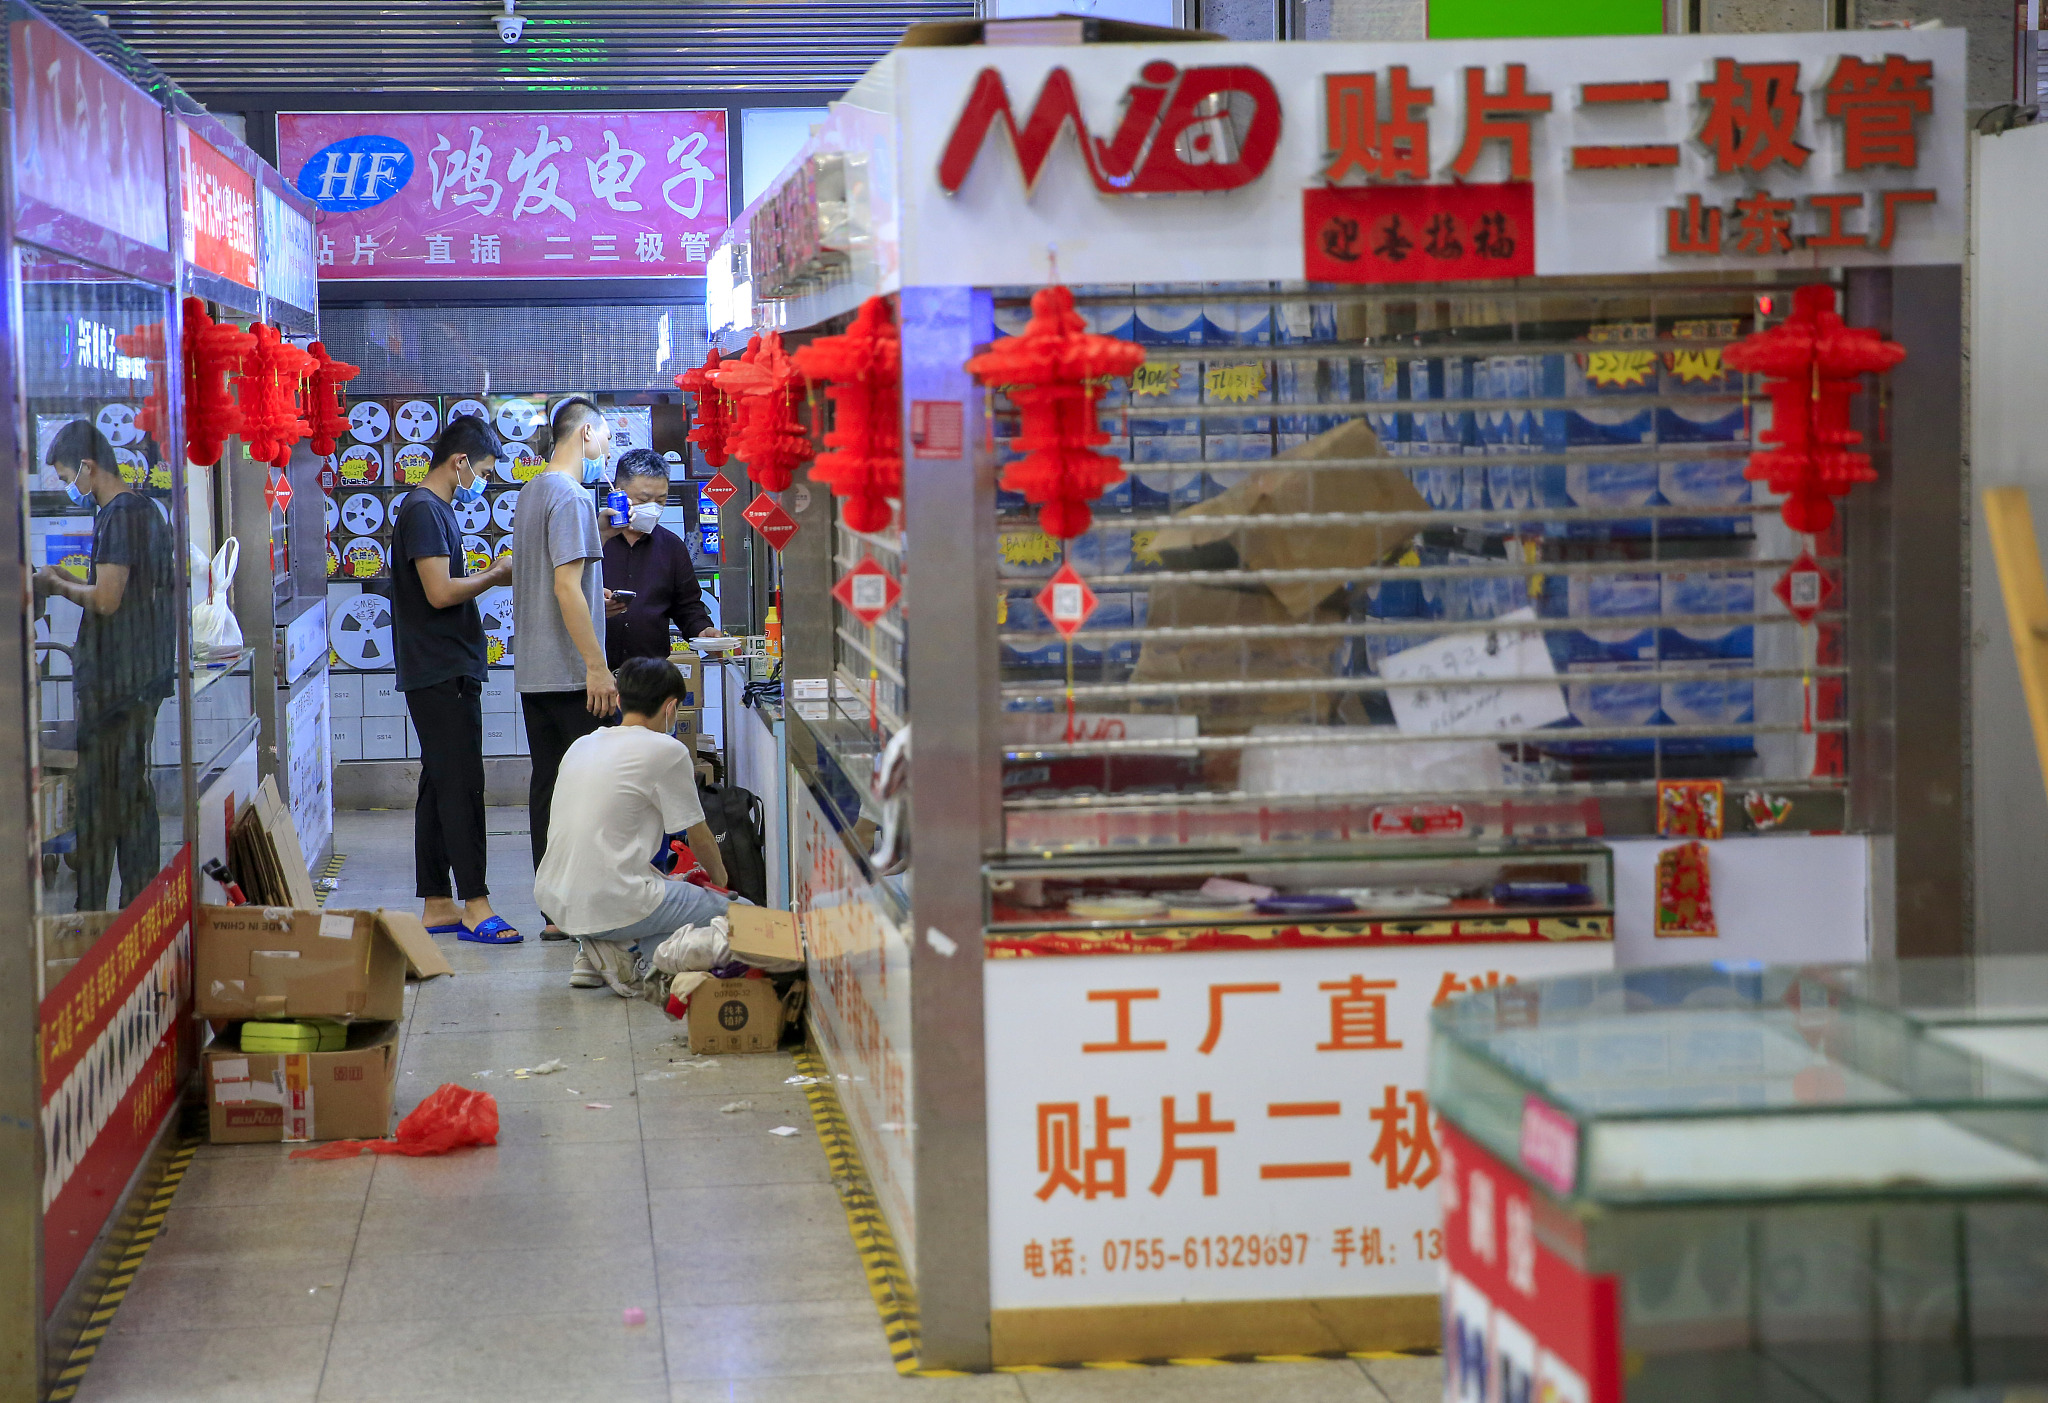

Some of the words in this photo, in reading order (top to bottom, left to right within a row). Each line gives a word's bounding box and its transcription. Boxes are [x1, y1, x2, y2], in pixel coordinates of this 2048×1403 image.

[1325, 54, 1934, 185] 贴片二极管
[317, 151, 408, 201] HF
[428, 125, 715, 221] 鸿发电子
[1667, 189, 1937, 256] 山东工厂
[425, 234, 501, 265] 直插
[544, 232, 711, 263] 二三极管
[213, 920, 246, 931] CHINA
[248, 920, 260, 931] IN
